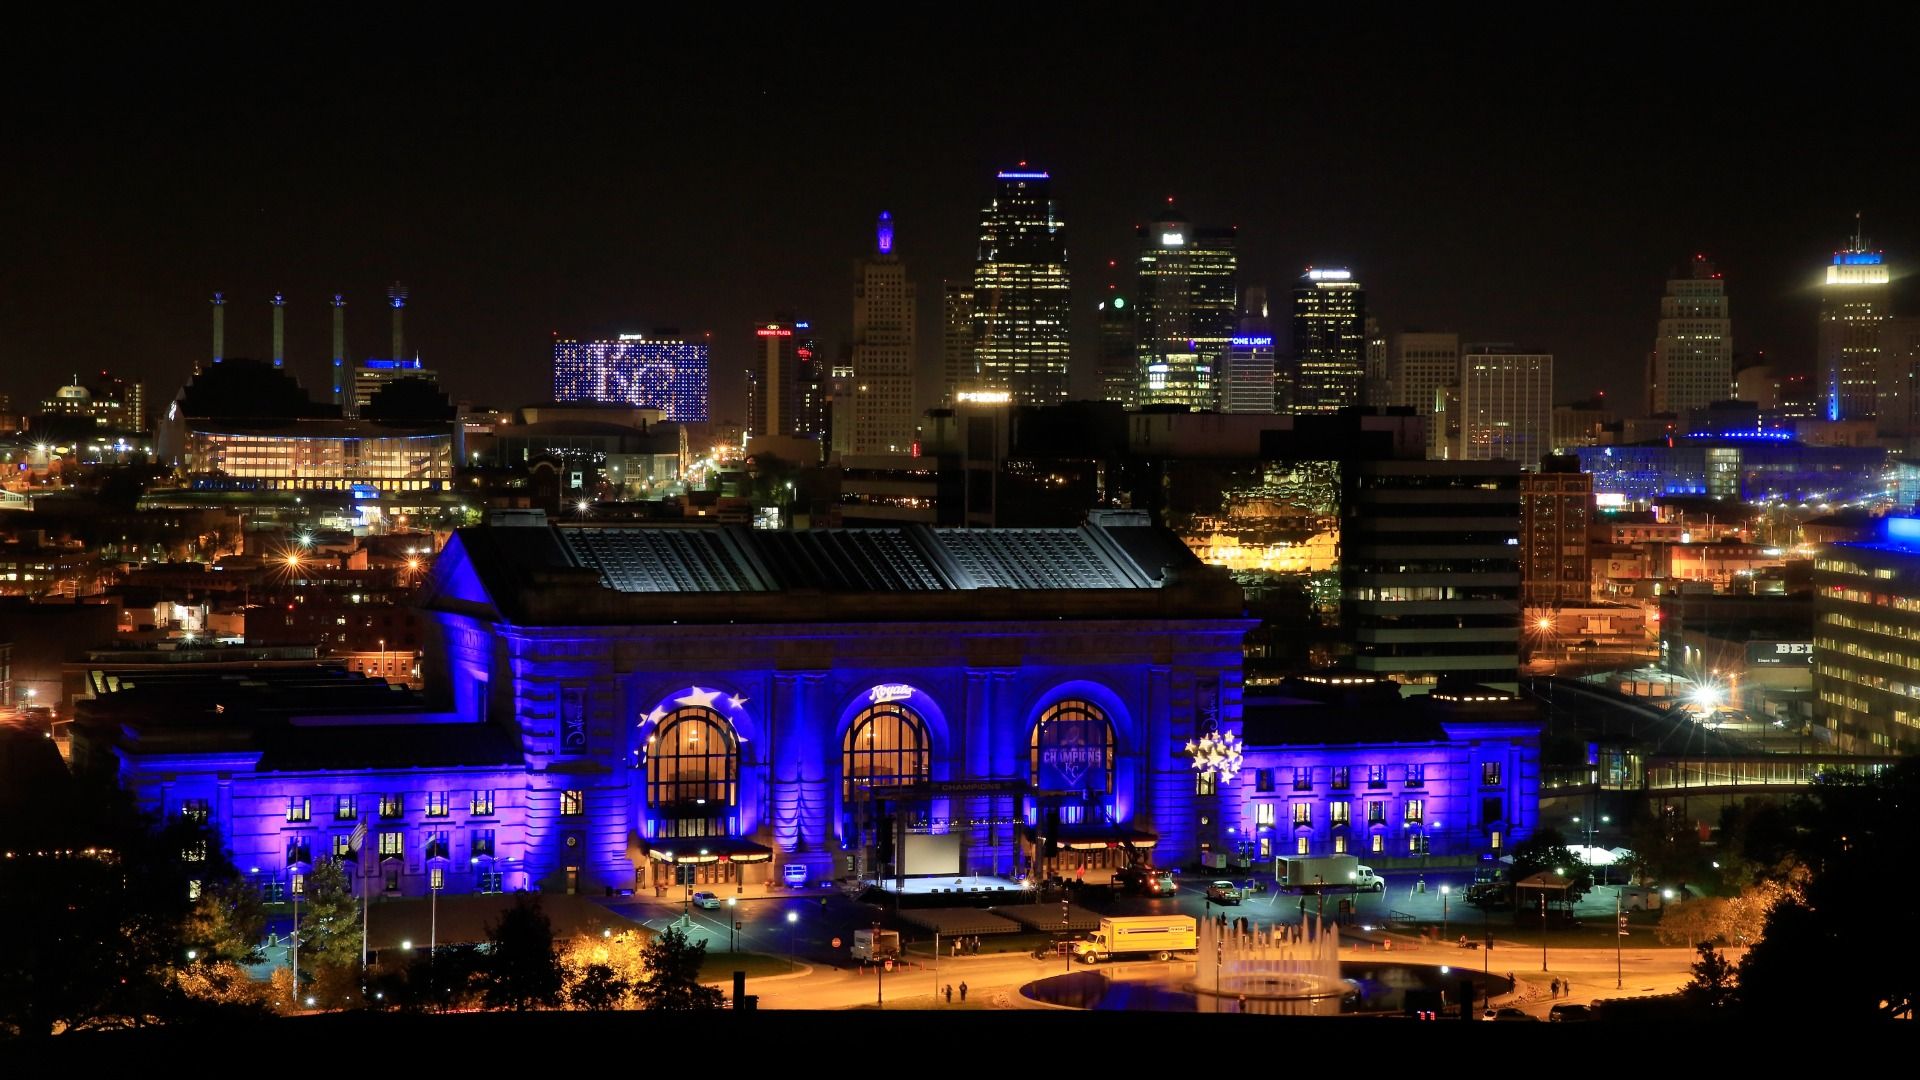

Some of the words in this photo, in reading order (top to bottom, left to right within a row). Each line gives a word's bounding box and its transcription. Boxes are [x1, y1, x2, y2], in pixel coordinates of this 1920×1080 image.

[1249, 337, 1272, 345] LIGHT
[869, 684, 914, 702] Royals
[1043, 751, 1101, 763] CHAMPIONS
[1065, 762, 1079, 779] KC
